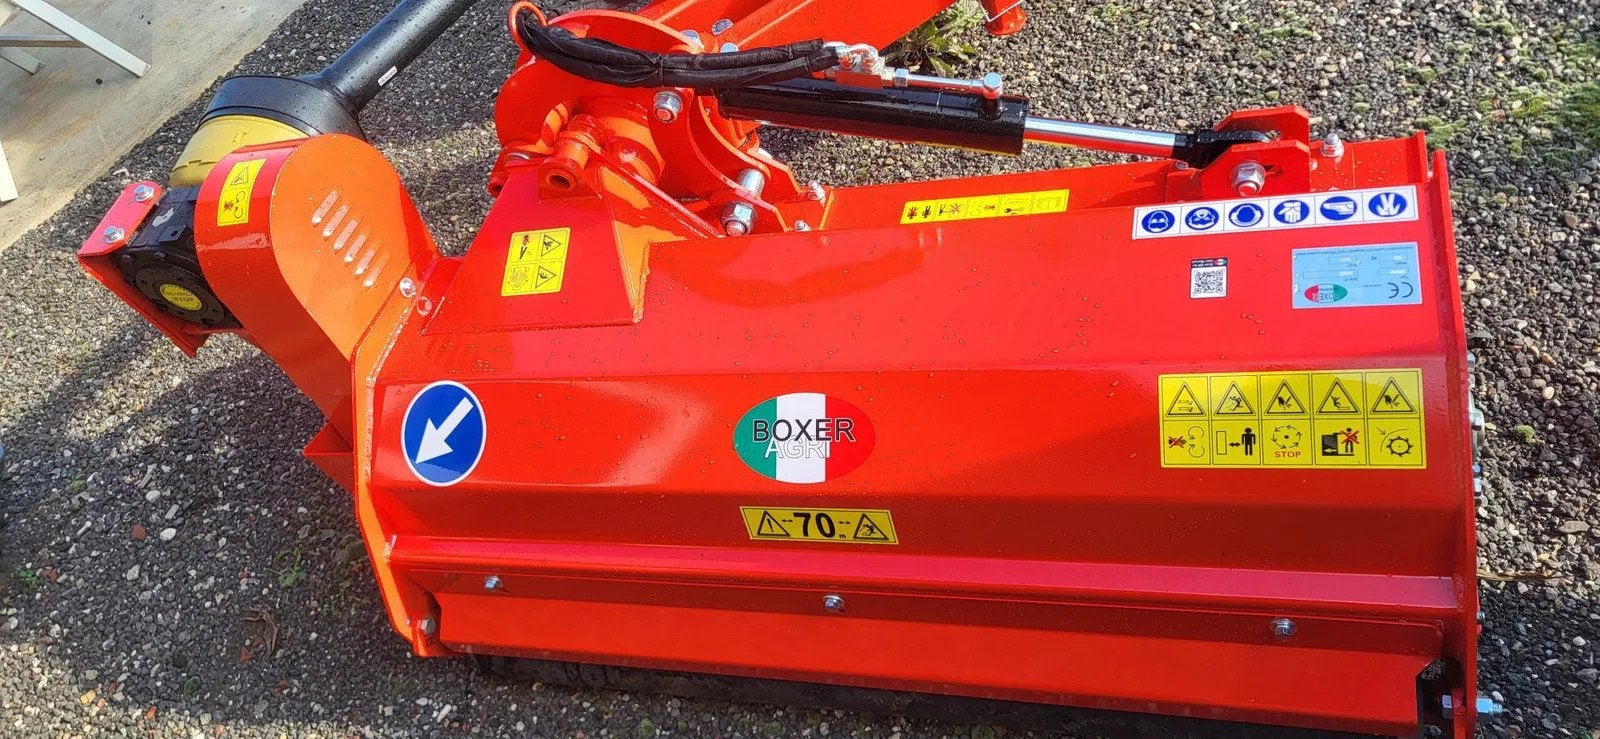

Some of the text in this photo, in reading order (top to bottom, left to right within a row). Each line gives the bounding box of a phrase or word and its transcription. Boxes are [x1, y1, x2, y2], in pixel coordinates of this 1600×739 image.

[1387, 281, 1413, 299] CE
[752, 418, 856, 442] BOXER
[764, 435, 830, 459] AGRI
[1274, 450, 1301, 459] STOP
[792, 512, 836, 539] 70
